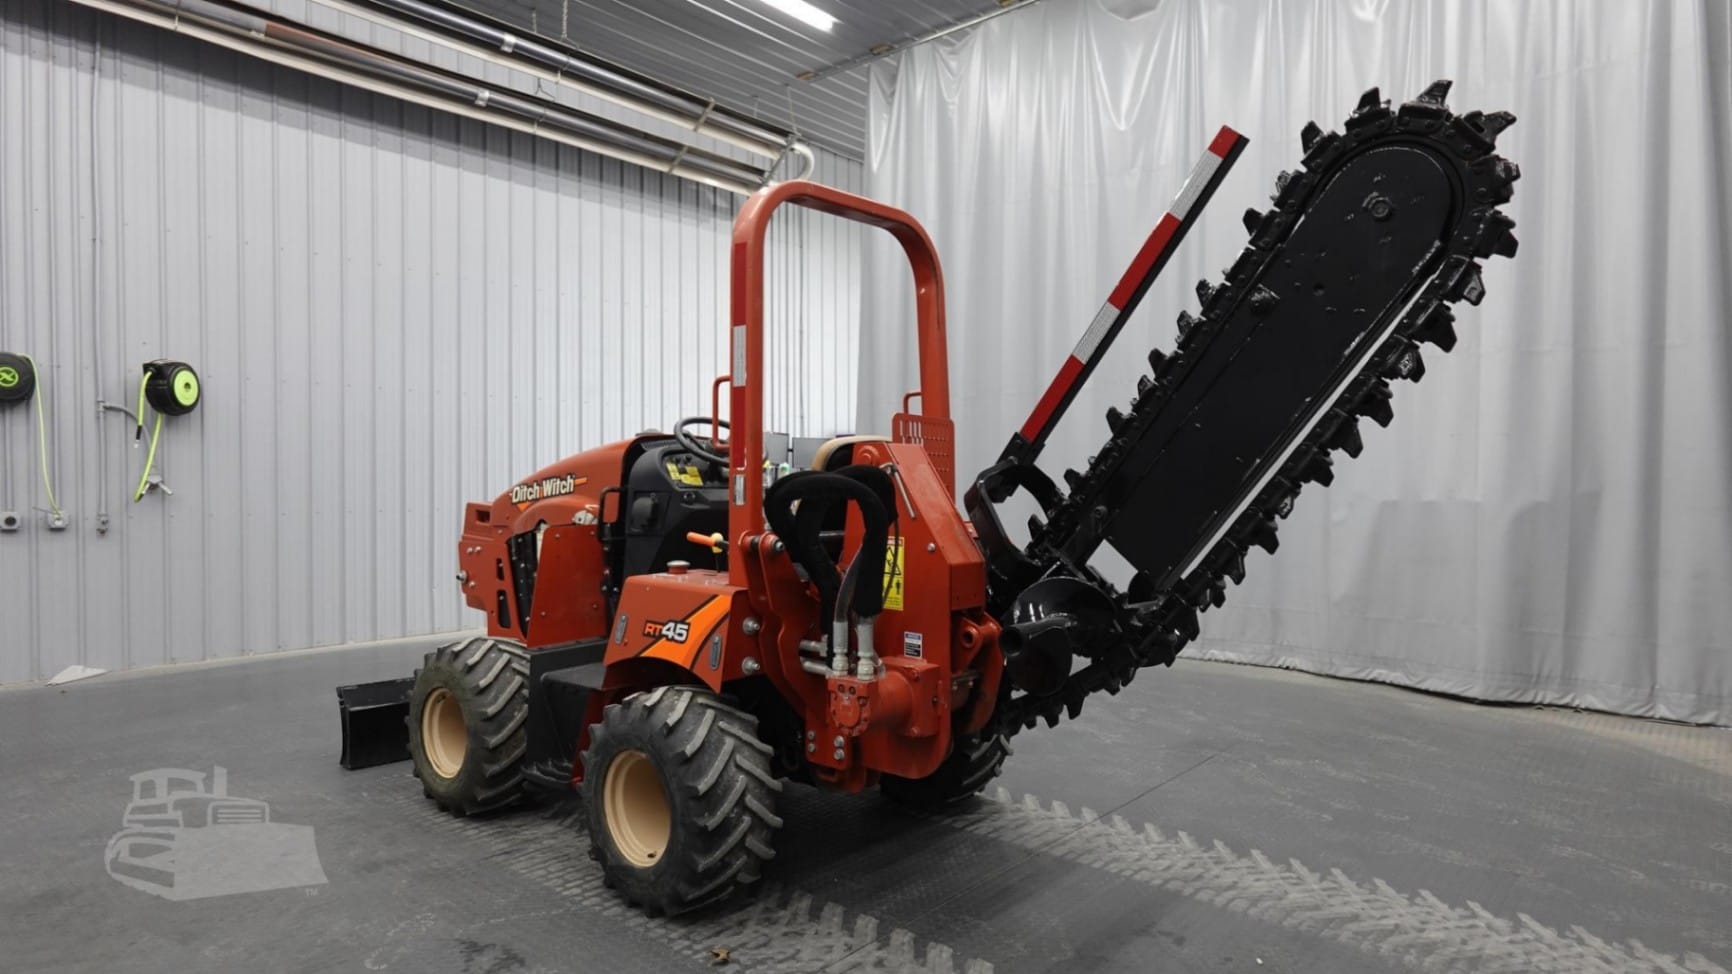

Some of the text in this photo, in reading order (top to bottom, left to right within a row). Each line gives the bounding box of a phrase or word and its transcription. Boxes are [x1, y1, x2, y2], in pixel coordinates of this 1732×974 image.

[511, 474, 574, 503] Ditch Witch
[644, 621, 689, 642] RT45
